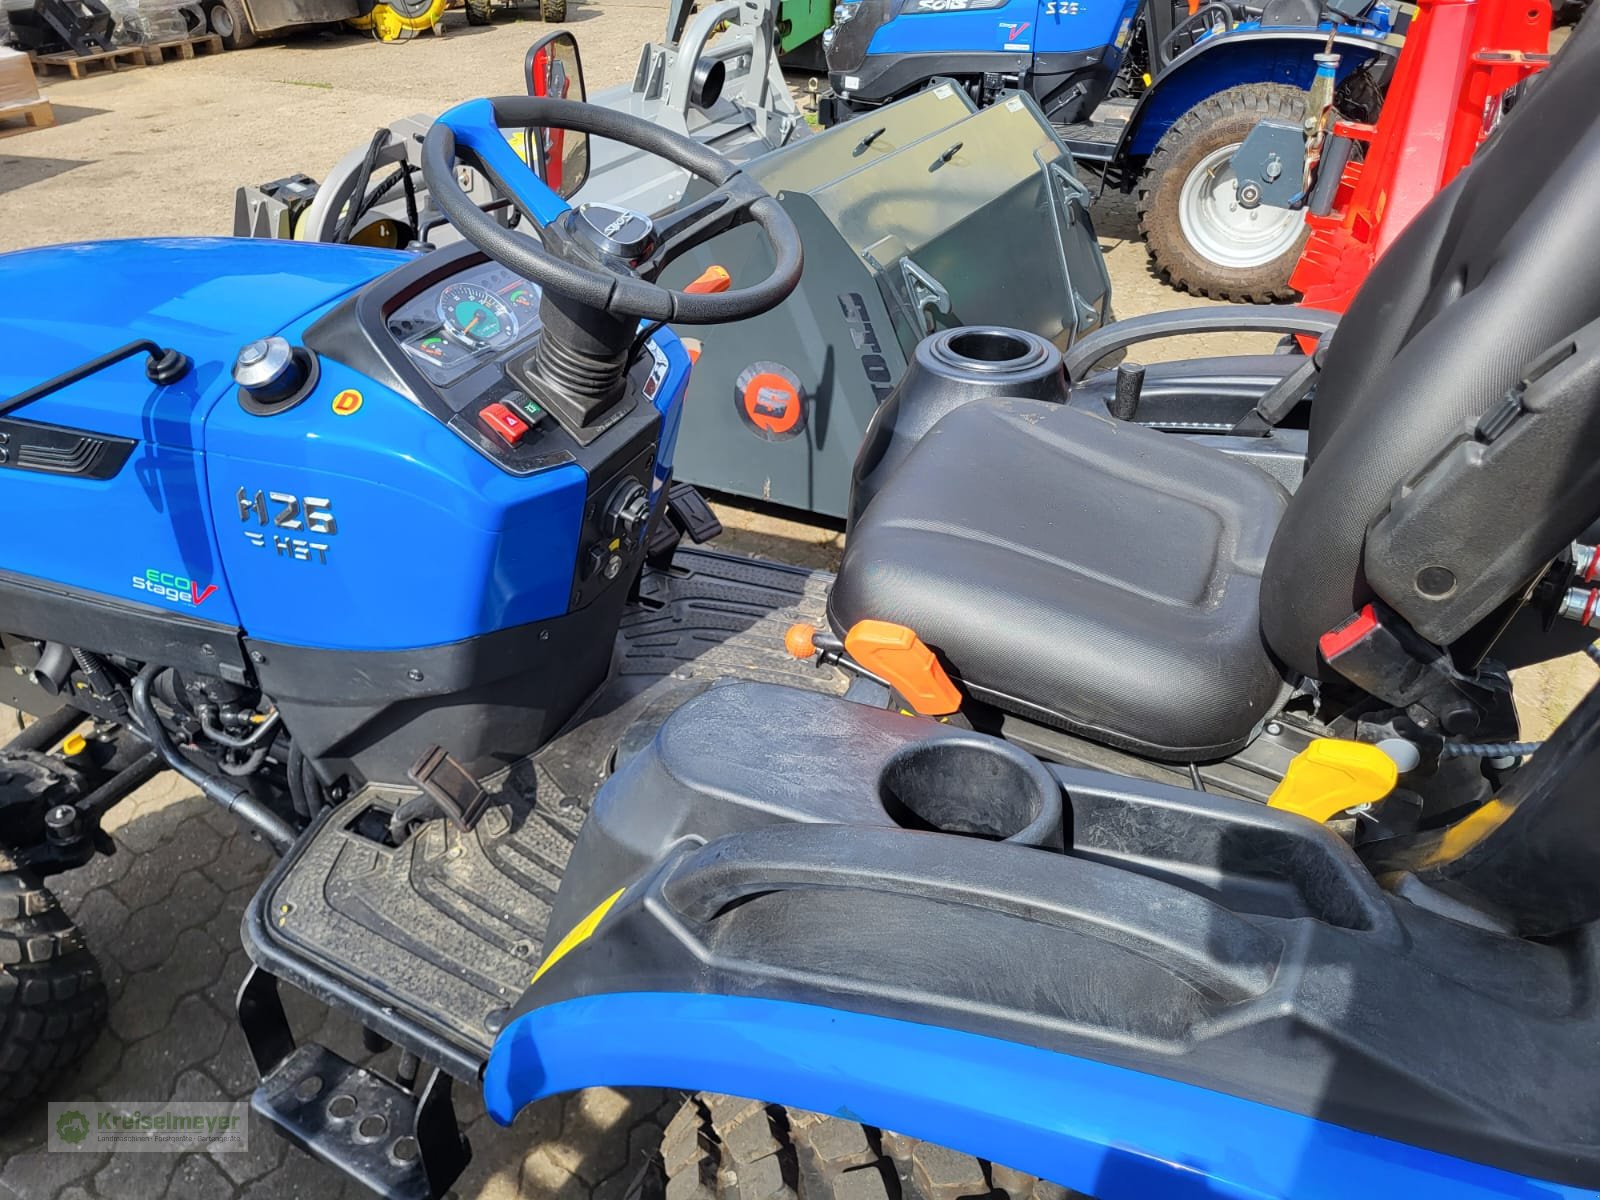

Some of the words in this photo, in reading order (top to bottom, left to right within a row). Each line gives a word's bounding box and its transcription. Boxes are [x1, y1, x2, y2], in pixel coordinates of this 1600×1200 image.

[335, 392, 359, 411] D
[236, 486, 337, 535] H26
[273, 534, 329, 564] HST
[132, 576, 192, 602] stage
[191, 580, 219, 606] V
